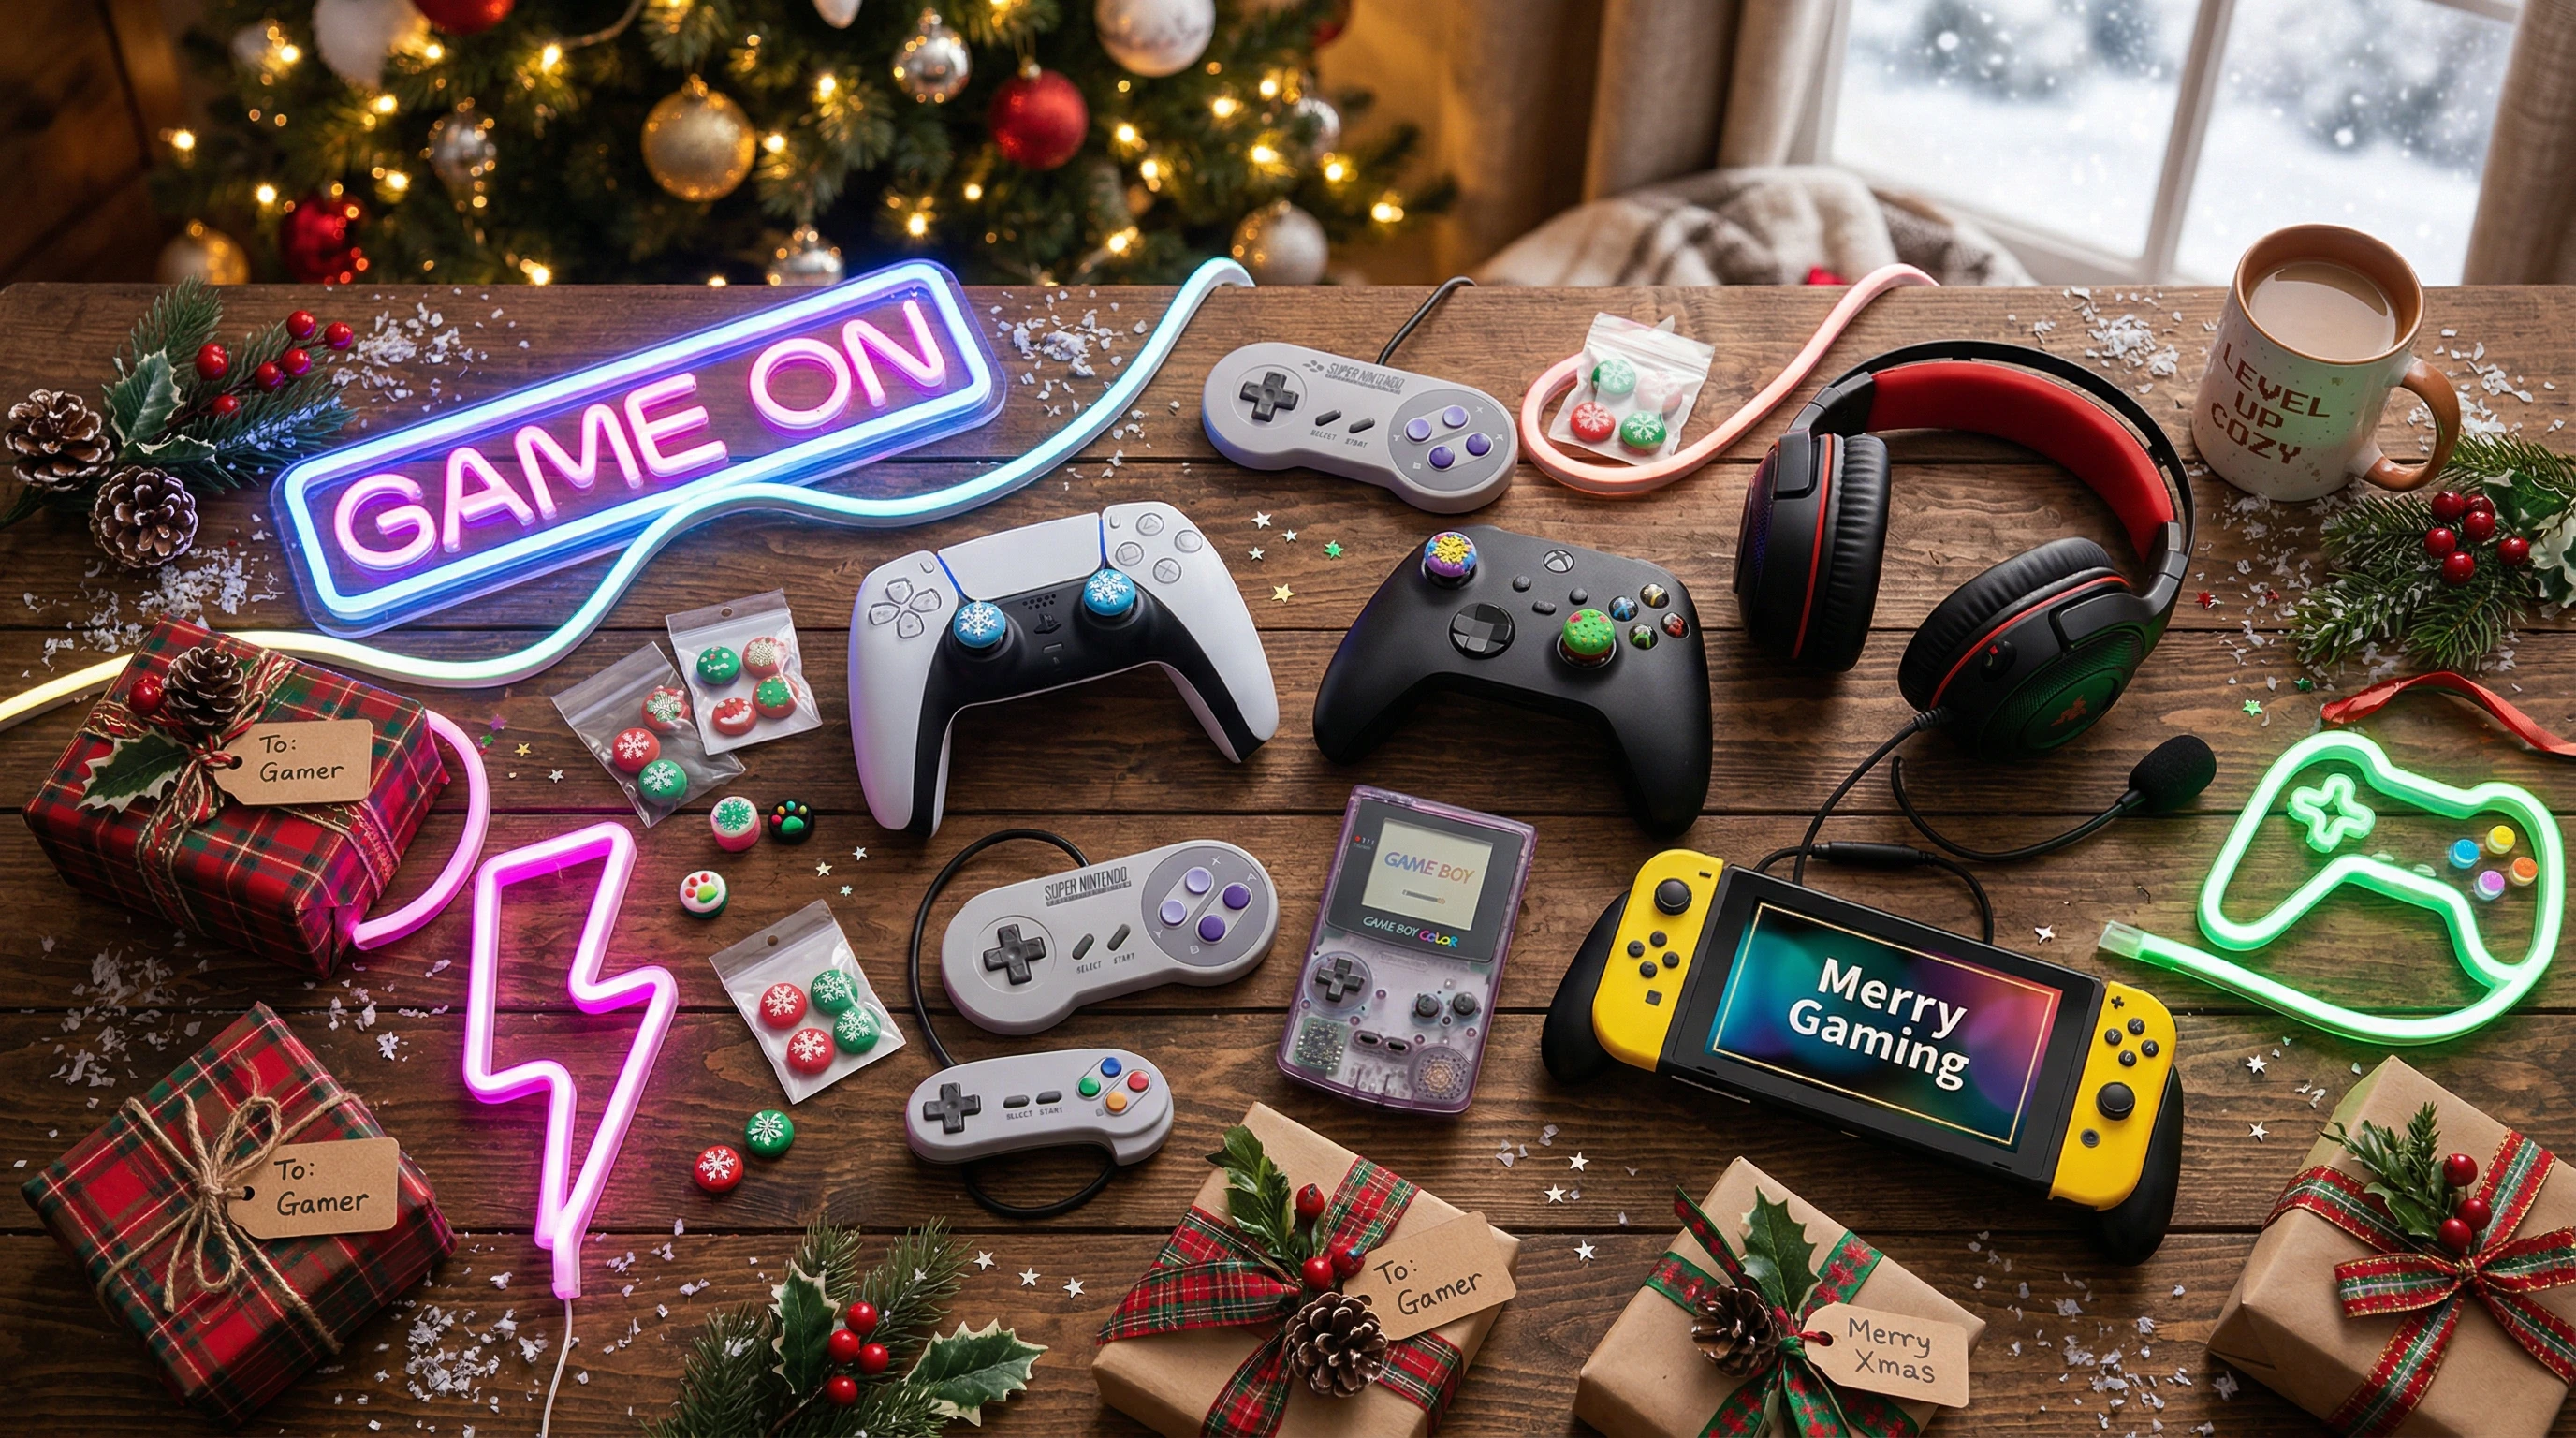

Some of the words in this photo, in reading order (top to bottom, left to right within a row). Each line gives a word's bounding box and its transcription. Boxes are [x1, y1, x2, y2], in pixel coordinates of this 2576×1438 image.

[2223, 342, 2331, 418] LEVEL
[2234, 390, 2284, 429] UP
[332, 372, 728, 570] GAME
[749, 299, 946, 430] ON
[2211, 402, 2302, 464] COZY
[258, 734, 296, 754] To:
[259, 761, 344, 783] Gamer
[1044, 877, 1077, 901] SUPER
[1079, 866, 1128, 893] NINTENDO
[1384, 851, 1438, 876] GAME
[1437, 863, 1476, 885] BOY
[1363, 917, 1397, 932] GAME
[1396, 924, 1420, 937] BOY
[1817, 957, 1968, 1040] Merry
[1789, 999, 1970, 1092] Gaming
[1039, 1107, 1063, 1116] START
[273, 1158, 315, 1181] To:
[277, 1191, 370, 1216] Gamer
[1373, 1259, 1418, 1285] To:
[1398, 1272, 1483, 1315] Gamer
[1848, 1317, 1931, 1359] Merry
[1855, 1348, 1936, 1384] Xmas
